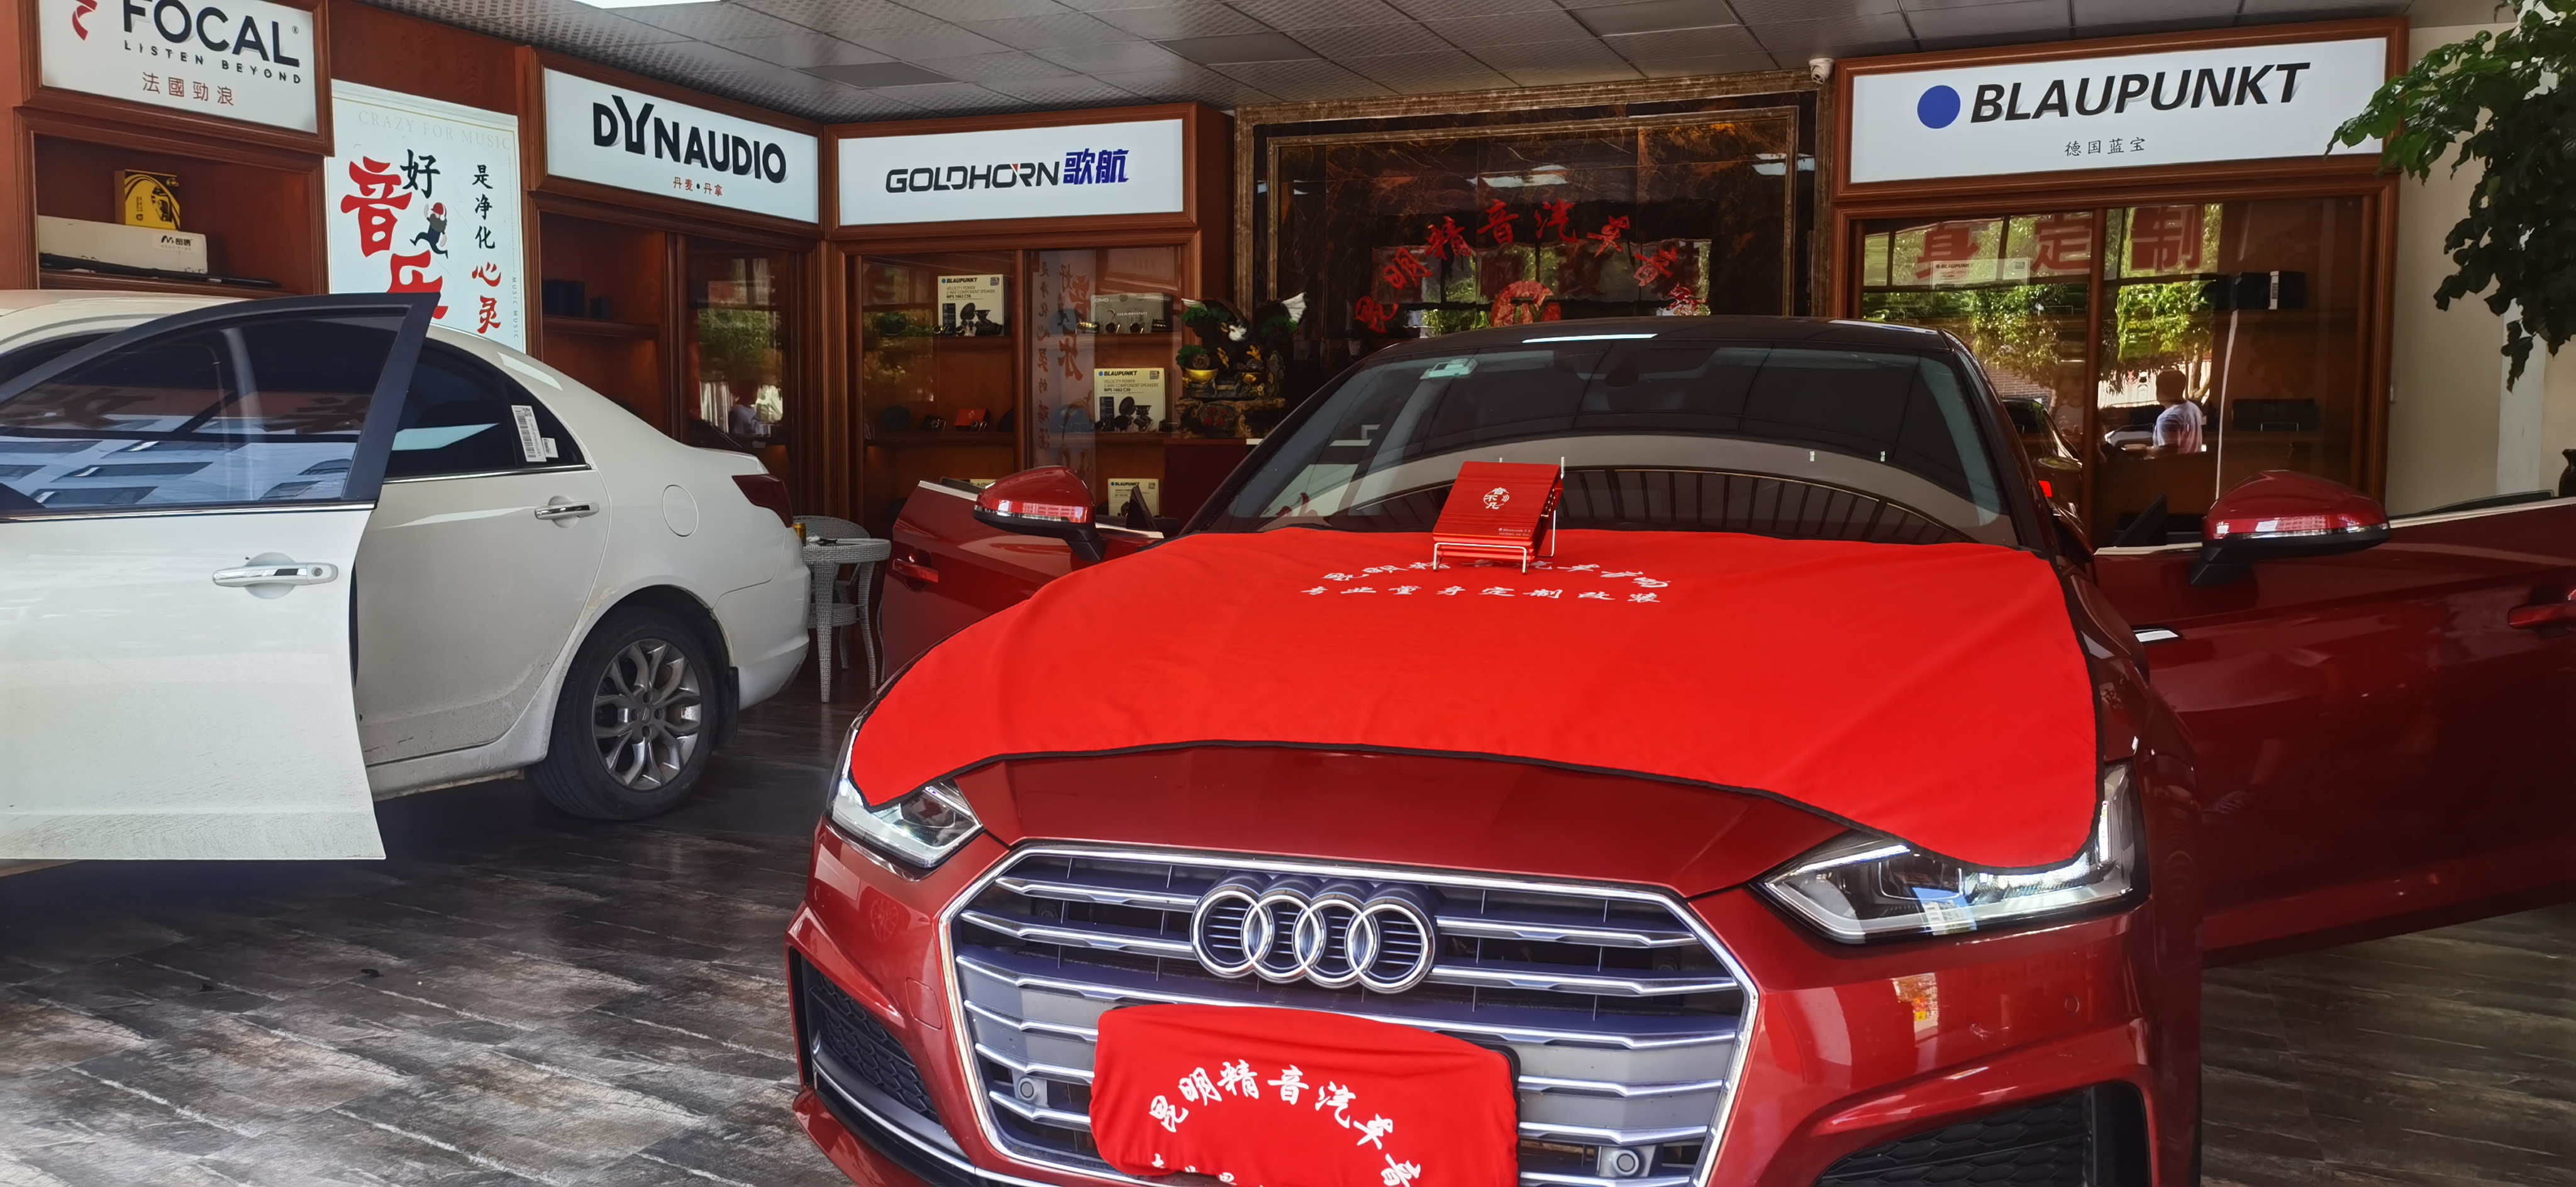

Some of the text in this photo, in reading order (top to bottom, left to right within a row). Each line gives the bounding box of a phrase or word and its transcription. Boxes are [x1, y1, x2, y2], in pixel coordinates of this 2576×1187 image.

[123, 0, 300, 67] FOCAL
[125, 40, 301, 84] LISTEN BEYOND
[142, 72, 234, 106] 法國勁浪
[1970, 62, 2311, 124] BLAUPUNKT
[358, 110, 511, 150] CRAZY FOR MUSIC
[592, 94, 787, 184] DYNAUDIO
[2063, 136, 2146, 157] 德国蓝宝
